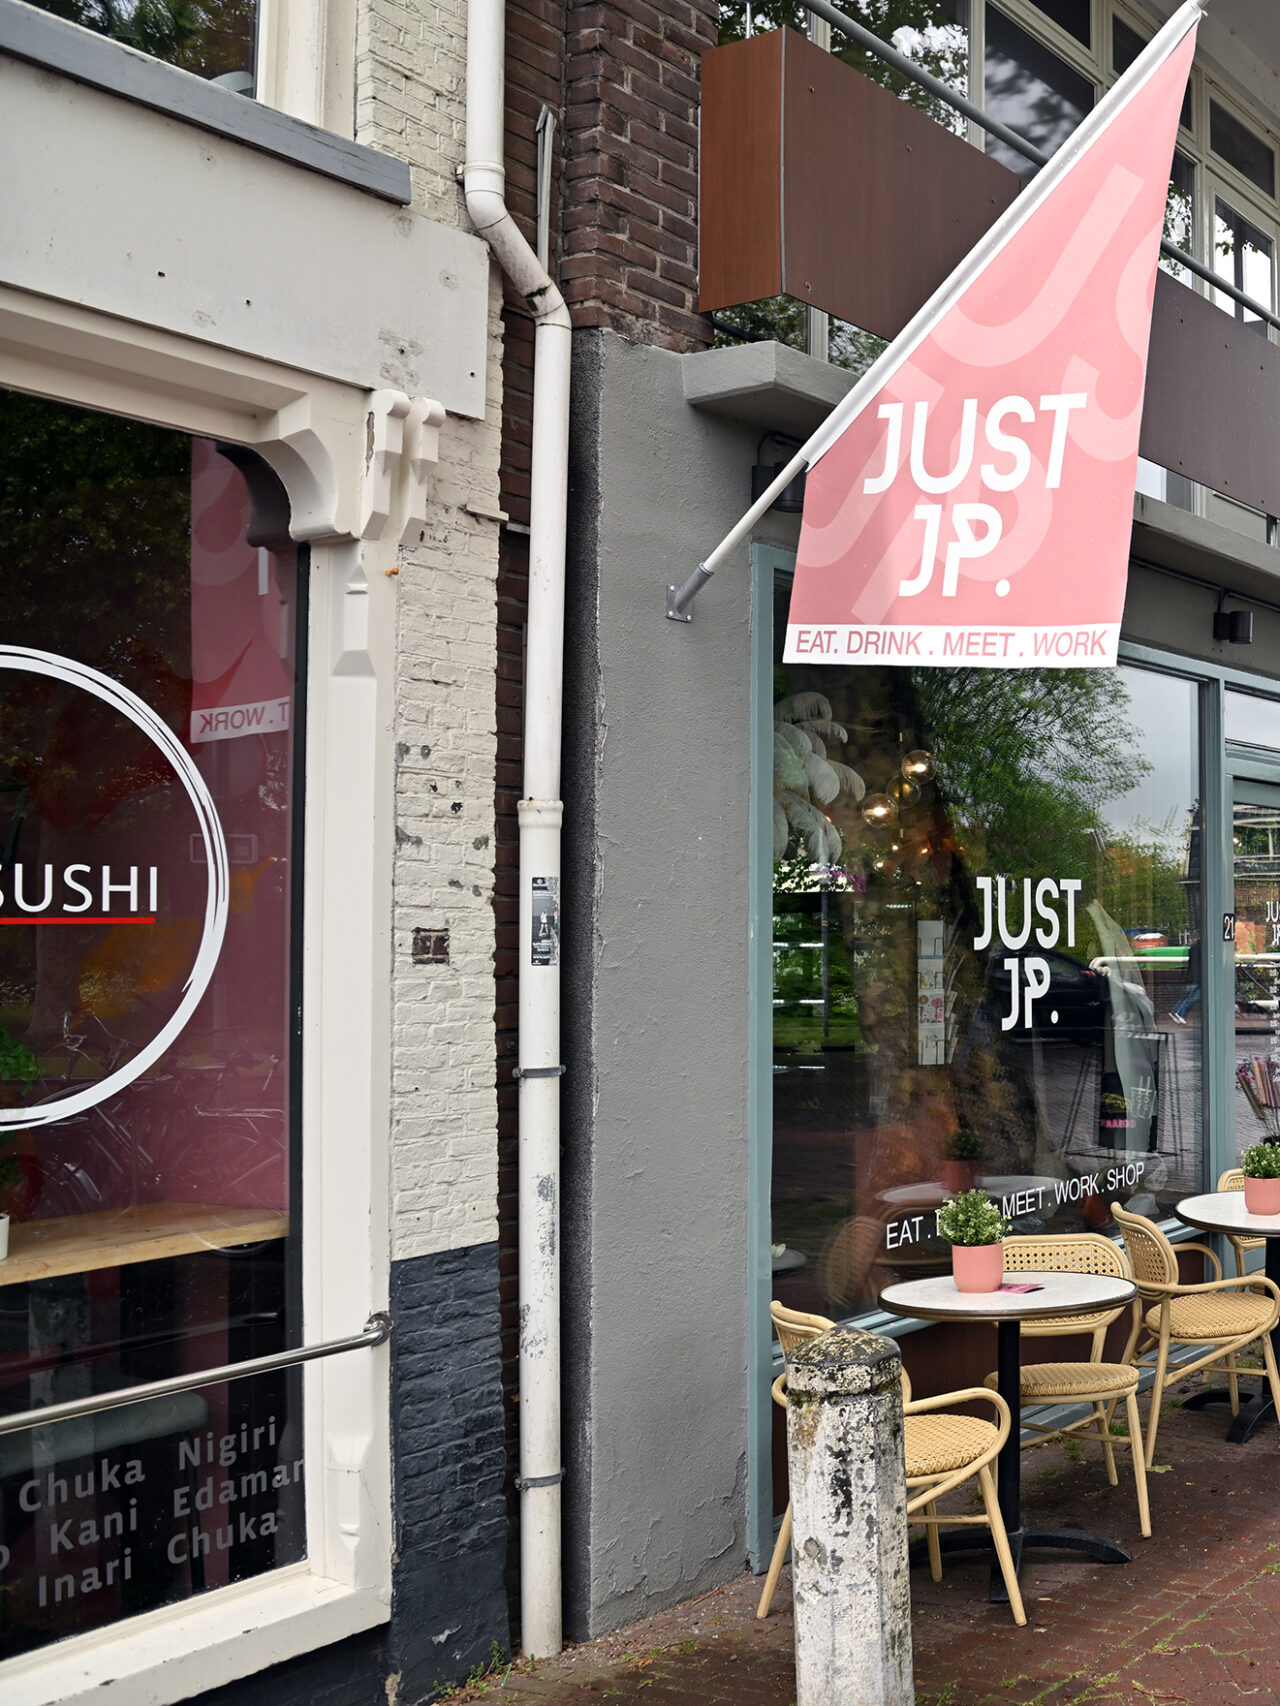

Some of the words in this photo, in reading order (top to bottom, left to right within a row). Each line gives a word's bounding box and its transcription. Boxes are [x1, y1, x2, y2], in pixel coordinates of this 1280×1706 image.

[863, 392, 1088, 494] JUST
[898, 503, 1010, 597] JP.
[846, 631, 923, 655] DRINK
[943, 632, 1015, 657] MEET
[1033, 630, 1108, 656] WORK
[0, 863, 158, 913] USHI
[973, 876, 1082, 950] JUST
[1224, 916, 1234, 940] 21
[1001, 957, 1059, 1031] JP.
[1002, 1187, 1046, 1218] MEET
[1054, 1173, 1100, 1204] WORK
[1107, 1162, 1145, 1191] SHOP
[19, 1458, 146, 1512] Chuka
[178, 1416, 277, 1471] Nigiri
[38, 1548, 132, 1608] Inari
[167, 1511, 279, 1565] Chuka
[50, 1498, 138, 1554] Kani
